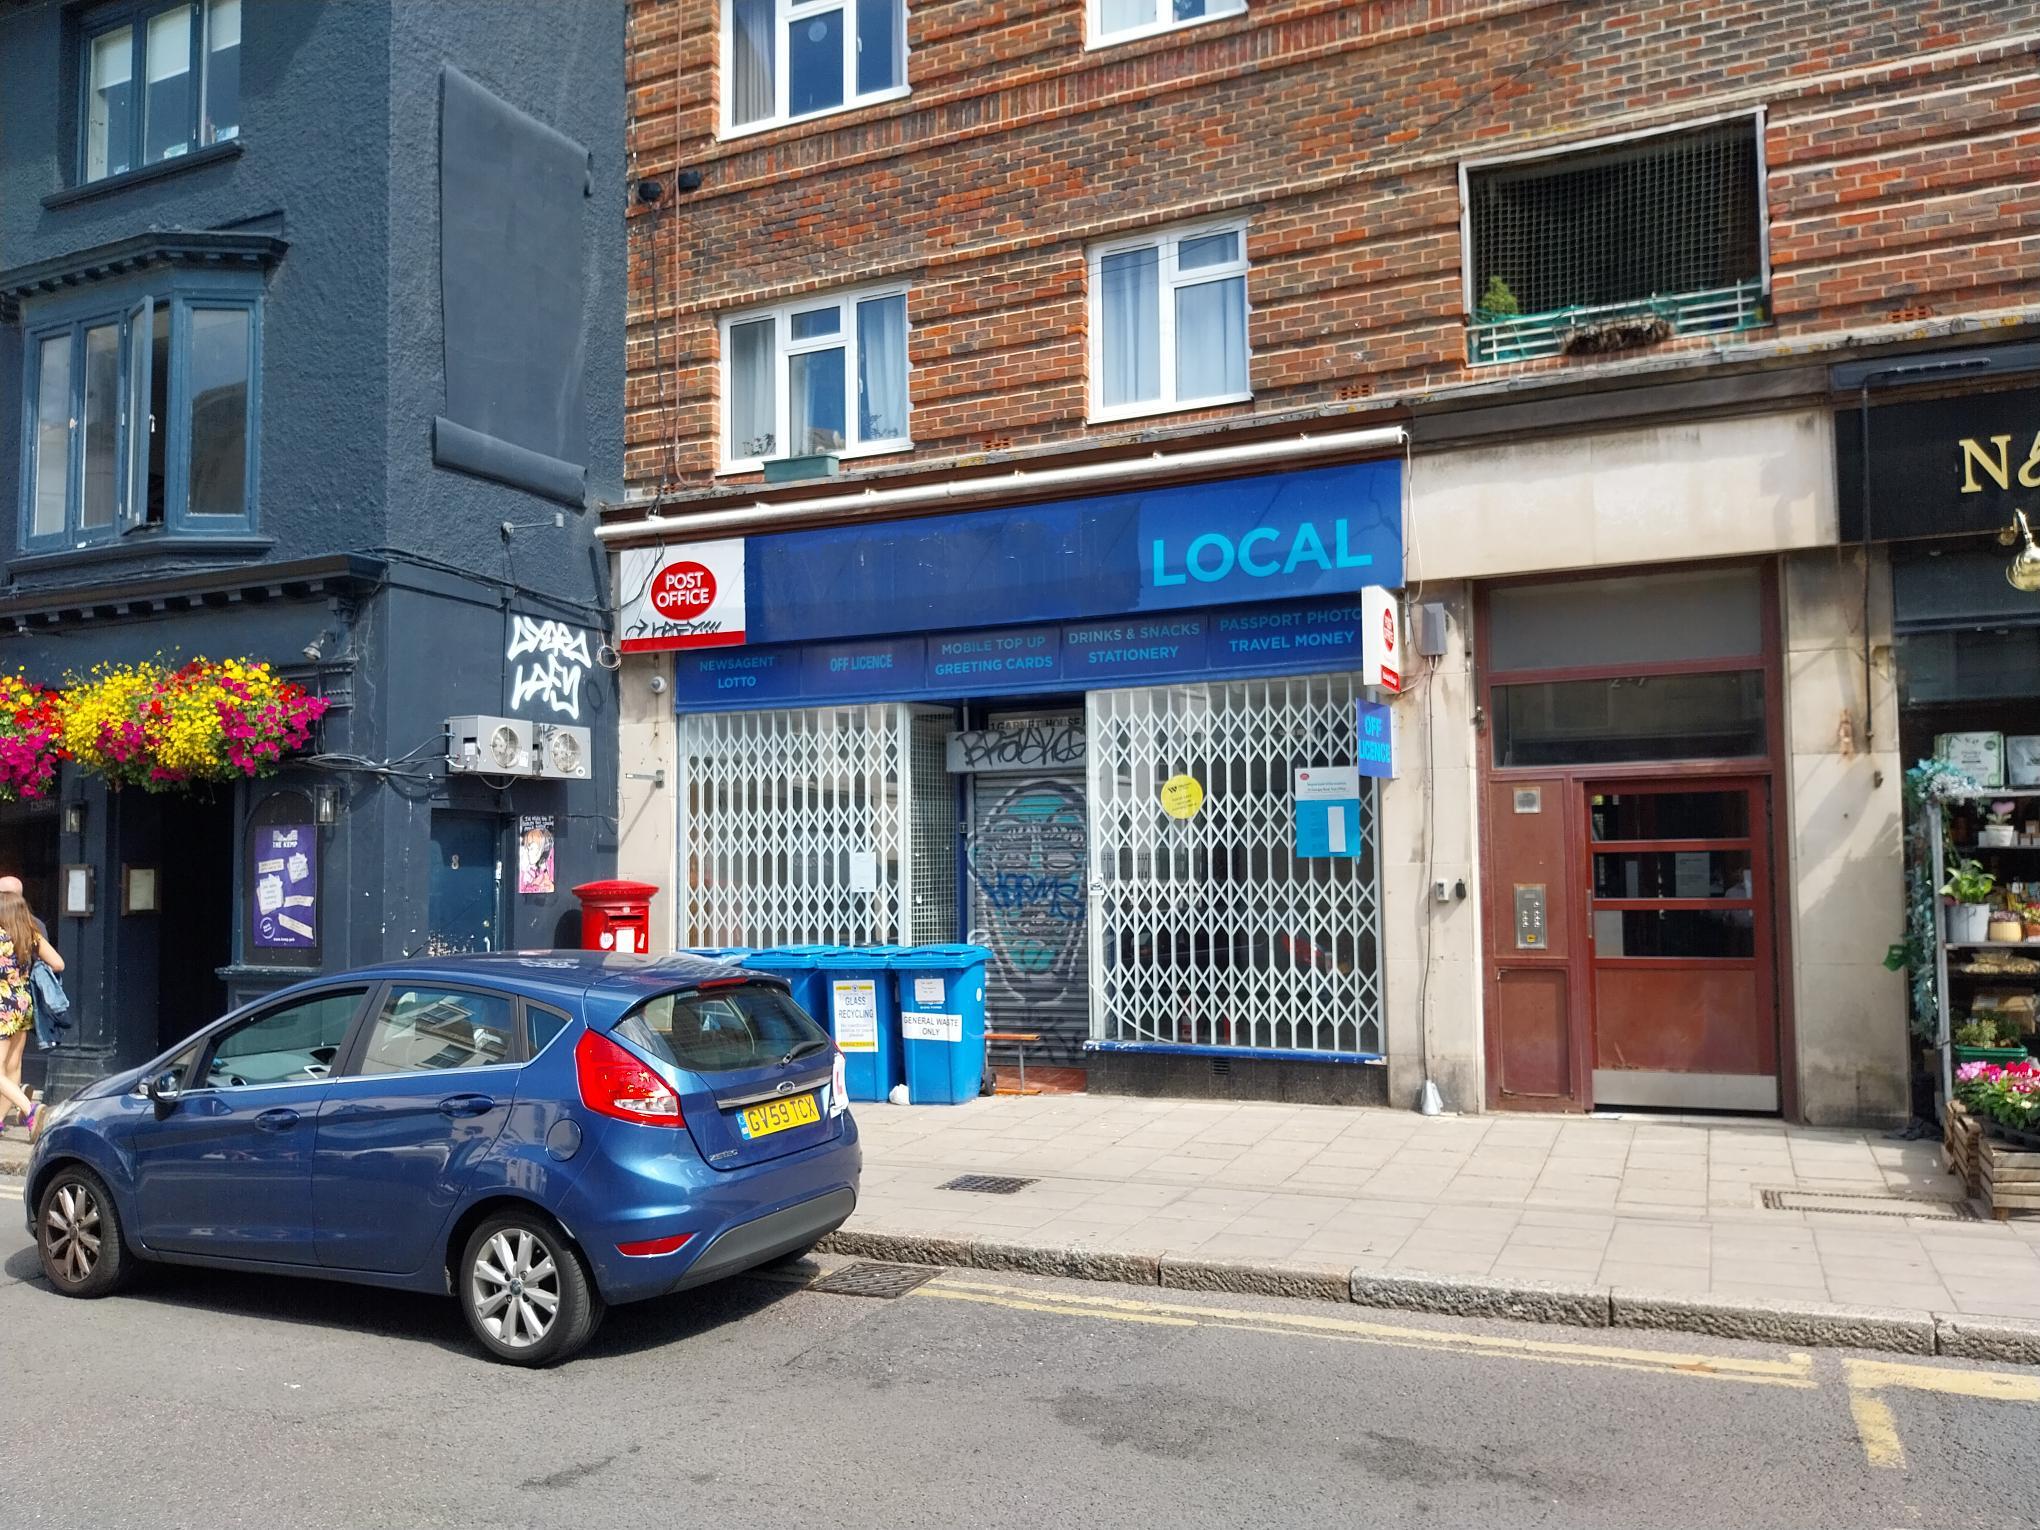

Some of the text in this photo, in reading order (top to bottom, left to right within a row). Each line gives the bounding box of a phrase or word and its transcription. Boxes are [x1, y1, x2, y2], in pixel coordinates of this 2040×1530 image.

[1152, 518, 1374, 587] LOCAL
[665, 571, 705, 591] POST
[656, 588, 710, 608] OFFICE
[1220, 612, 1302, 632] PASSPORT
[1068, 623, 1200, 644] DRINKS & SNACKS
[1228, 631, 1355, 653] TRAVEL MONEY
[942, 636, 1046, 655] MOBILE TOP UP
[1088, 646, 1180, 664] STATIONERY
[700, 655, 776, 672] NEWSAGENT
[830, 654, 894, 672] OFF LICENCE
[935, 656, 1054, 676] GREETING CARDS
[718, 676, 757, 689] LOTTO
[1364, 713, 1381, 737] OFF
[1358, 739, 1391, 763] LICENCE
[844, 996, 867, 1006] GLASS
[838, 1009, 874, 1019] RECYCLING
[903, 1015, 959, 1027] GENERAL WASTE
[921, 1027, 941, 1036] ONLY
[748, 1096, 817, 1132] GV59 TCX
